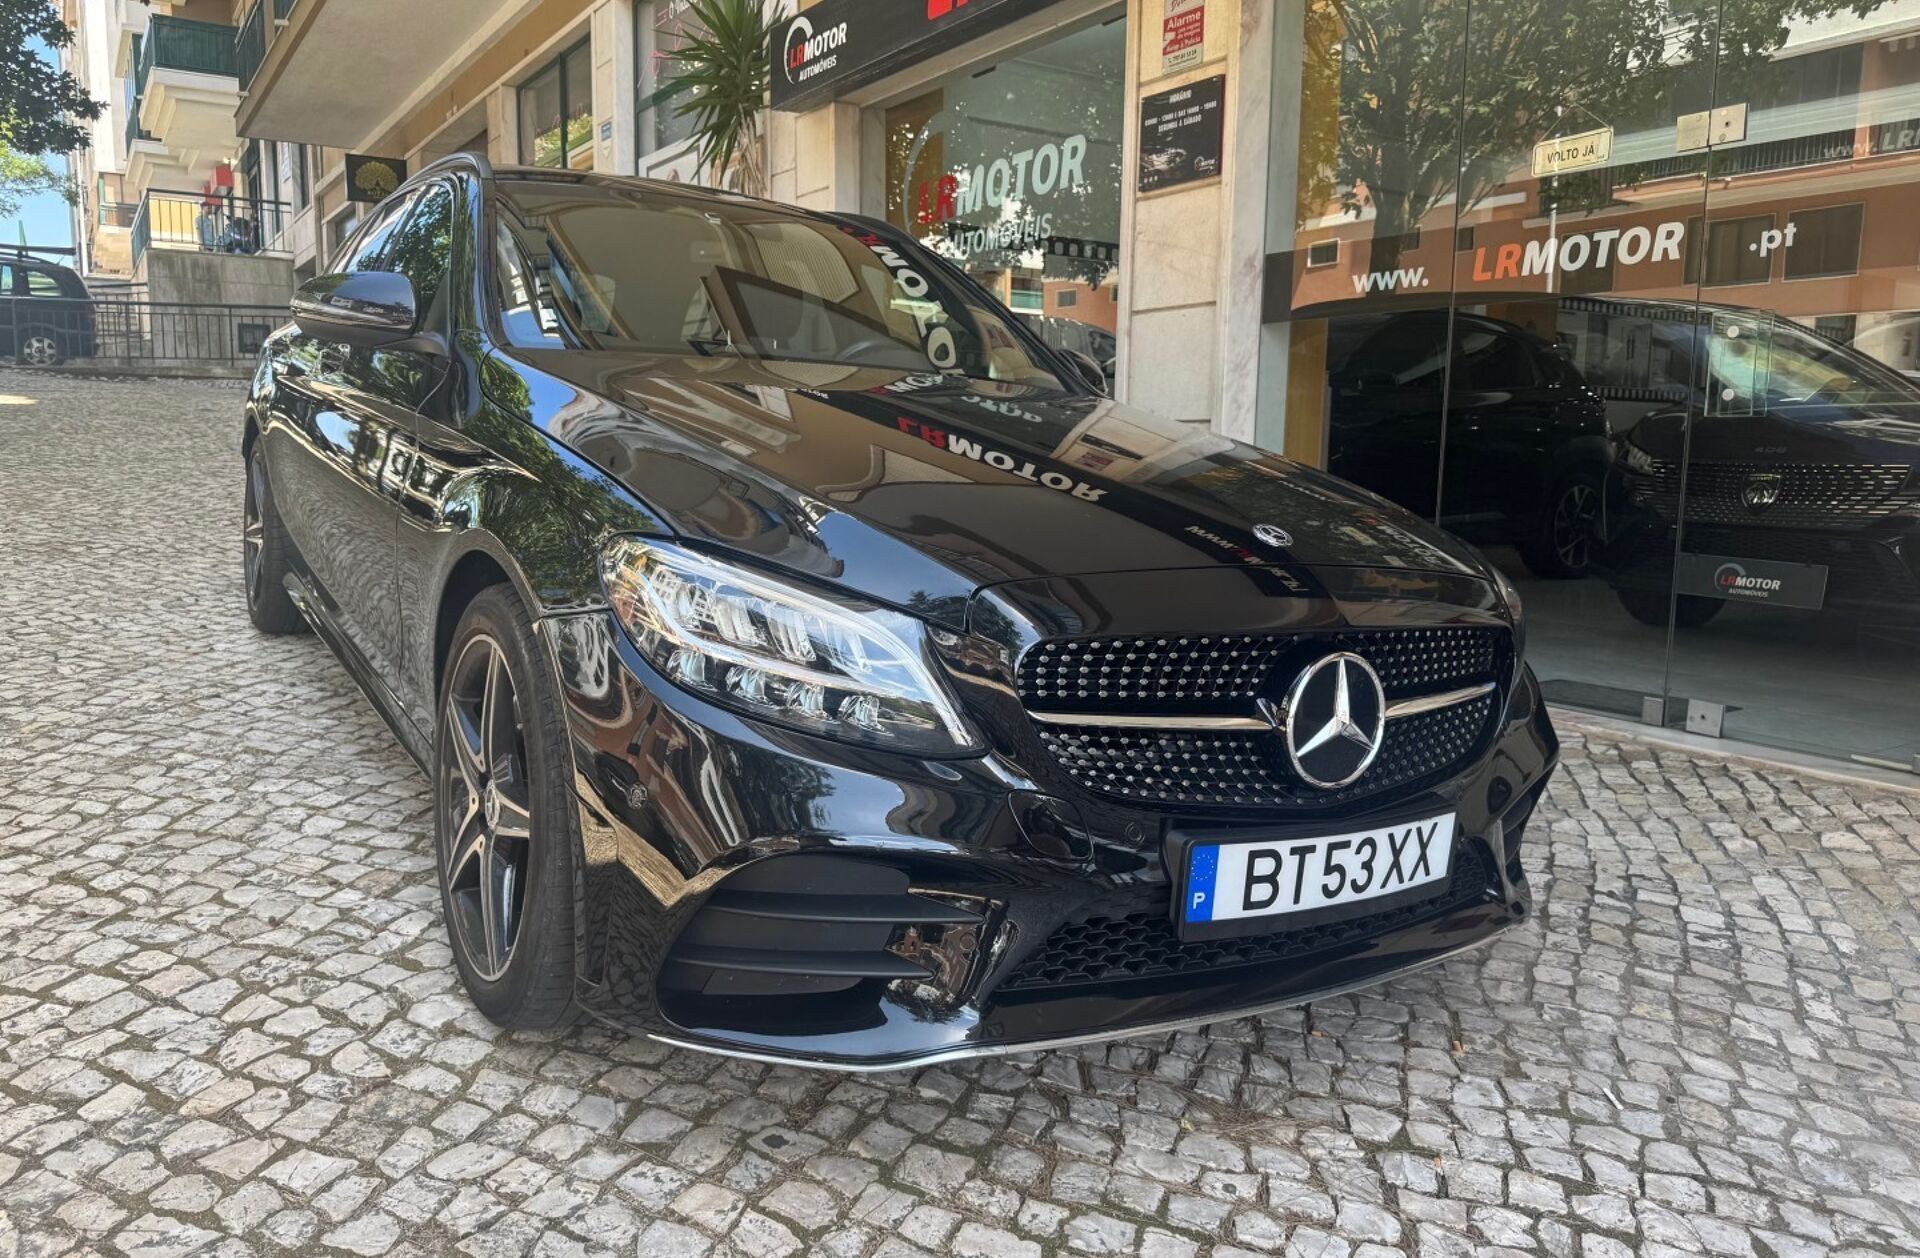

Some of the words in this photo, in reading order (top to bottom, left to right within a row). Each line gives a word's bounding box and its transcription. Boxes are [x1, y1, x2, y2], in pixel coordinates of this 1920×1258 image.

[789, 21, 848, 69] LRMOTOR
[1167, 11, 1201, 31] Alarme
[1547, 147, 1579, 164] VOLTO
[1582, 141, 1595, 157] JÁ
[918, 134, 1087, 224] LRMOTOR
[1352, 266, 1430, 294] www.
[1472, 221, 1685, 282] LRMOTOR
[1720, 575, 1782, 591] LRMOTOR
[1192, 892, 1206, 909] P
[1241, 821, 1439, 912] BT53XX
